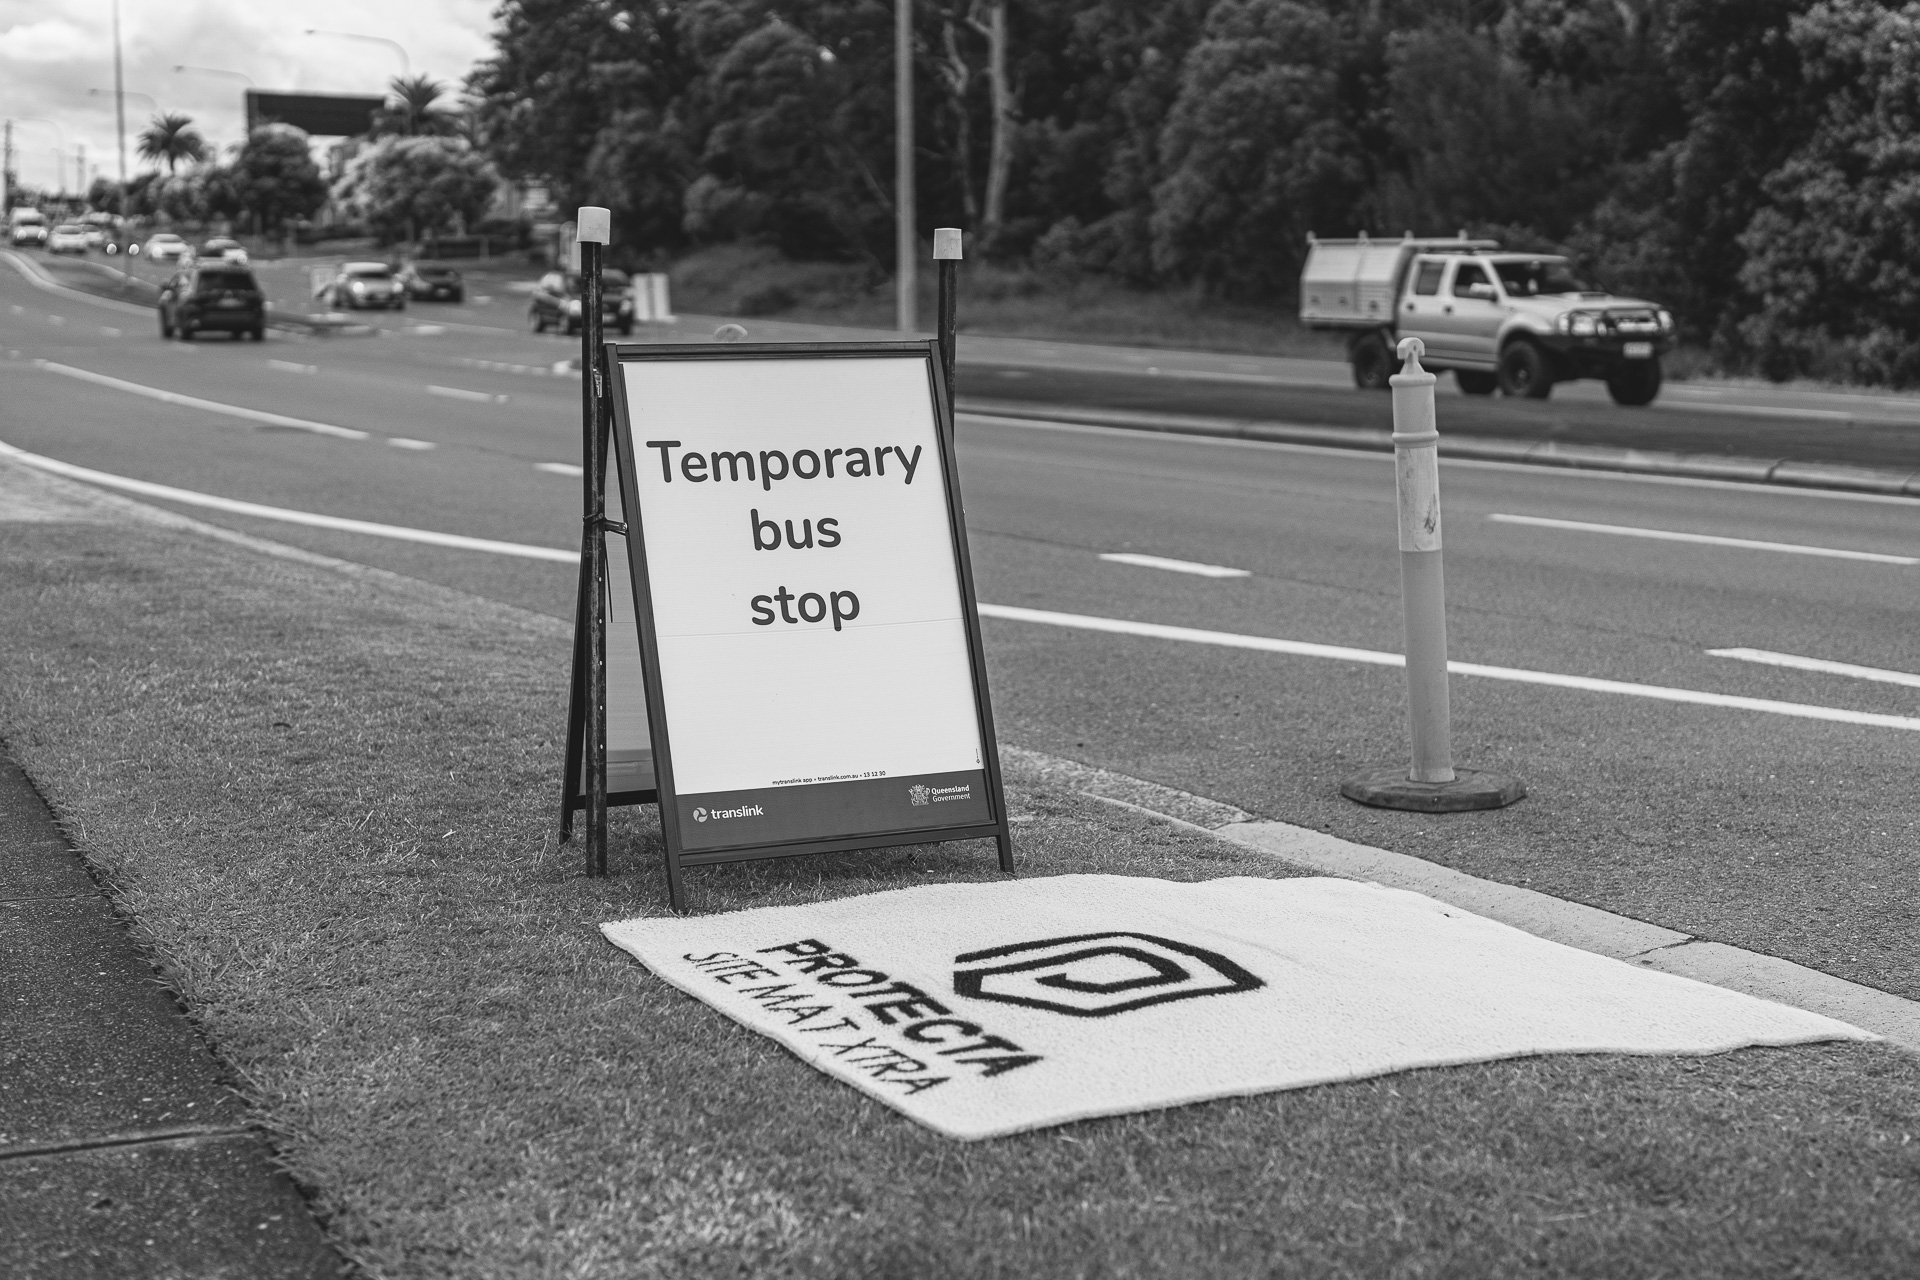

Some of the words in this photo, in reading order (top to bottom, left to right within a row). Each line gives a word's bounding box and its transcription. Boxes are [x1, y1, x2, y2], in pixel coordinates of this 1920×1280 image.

[646, 440, 922, 491] Temporary
[750, 508, 842, 551] bus
[750, 585, 860, 631] stop
[817, 773, 858, 782] translink.com.au
[931, 784, 970, 796] Queensland
[932, 792, 971, 803] Government
[710, 804, 764, 820] translink
[683, 951, 780, 985] SITE
[738, 983, 861, 1033] MAT
[819, 1037, 951, 1095] XTRA
[755, 938, 1044, 1078] PROTECTA
